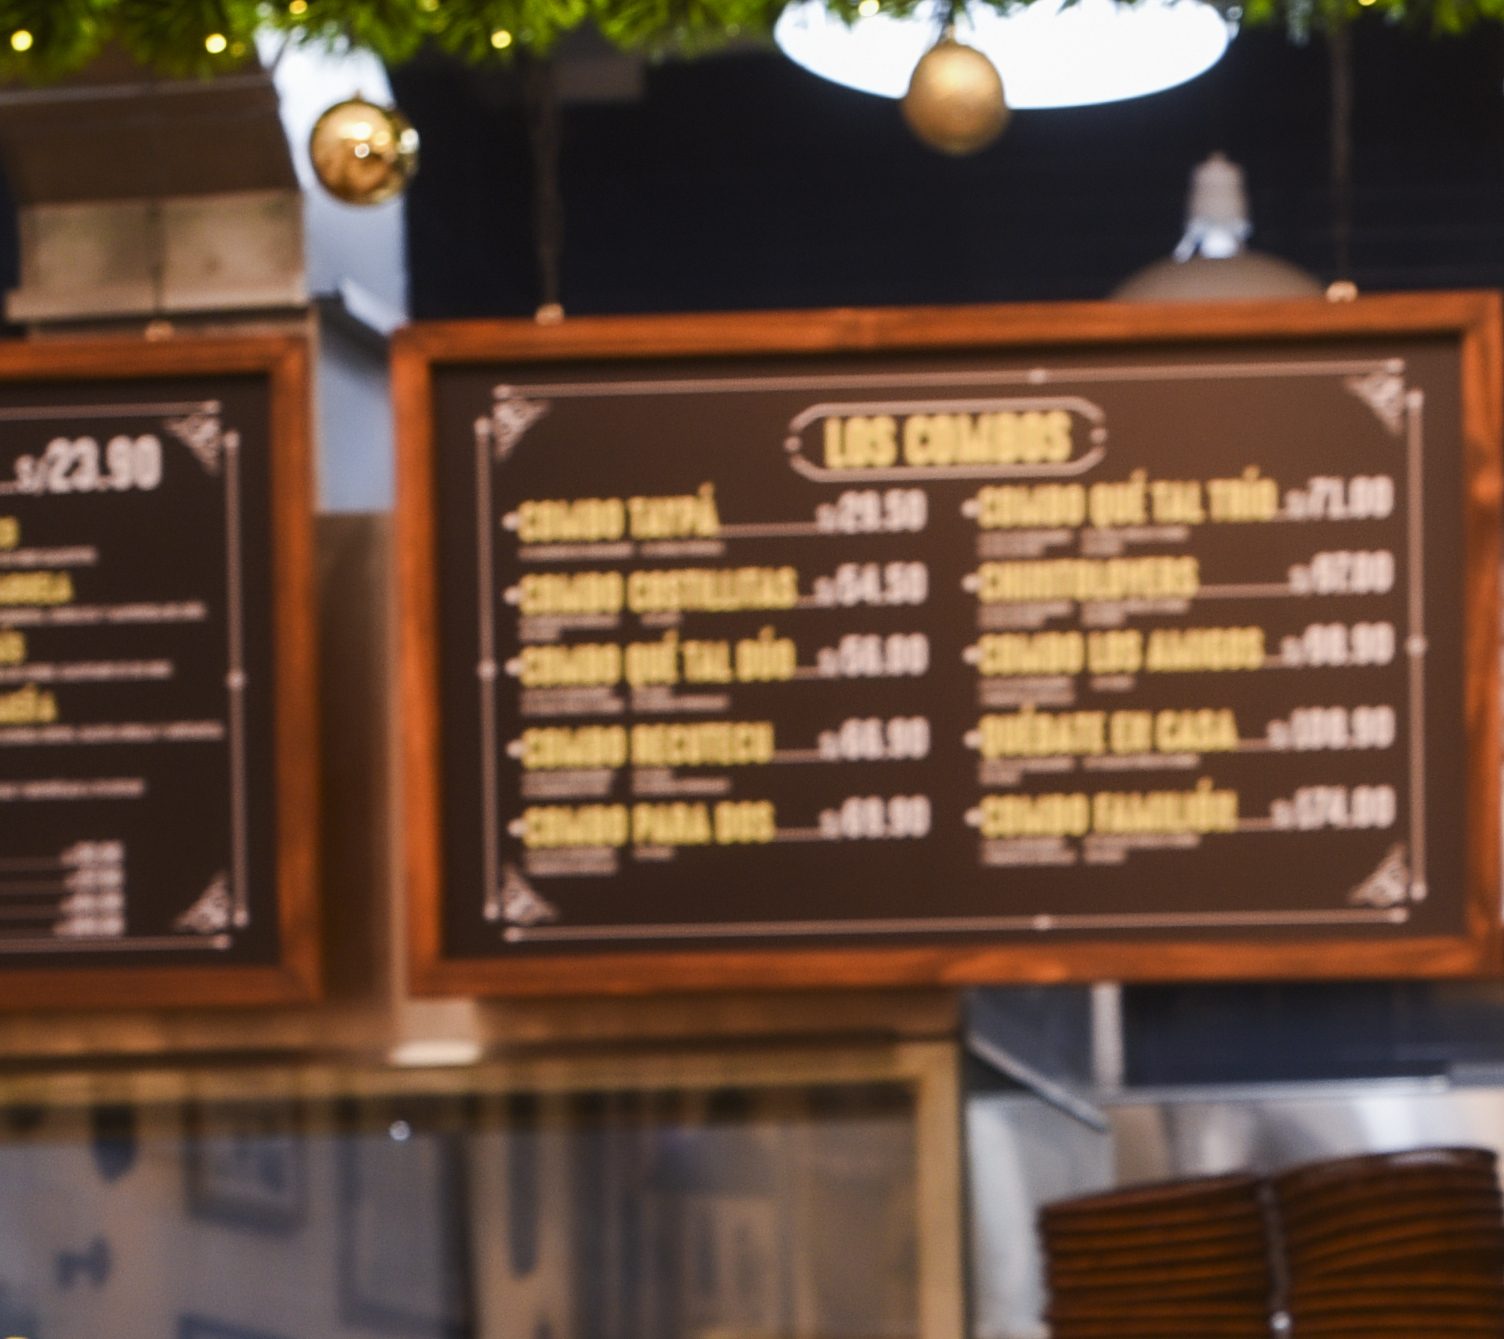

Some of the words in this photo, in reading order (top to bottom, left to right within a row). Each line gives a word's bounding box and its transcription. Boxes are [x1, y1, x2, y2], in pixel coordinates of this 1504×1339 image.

[824, 415, 896, 468] LOS
[904, 411, 1071, 466] COMBOS
[16, 437, 161, 491] S/23.90
[518, 500, 622, 541] COMBO
[978, 487, 1084, 526] COMBO
[518, 573, 622, 615] COMBO
[519, 645, 621, 687] COMBO
[979, 635, 1084, 675] COMBO
[521, 727, 626, 769] COMBO
[524, 806, 628, 847] COMBO
[981, 795, 1086, 837] COMBO
